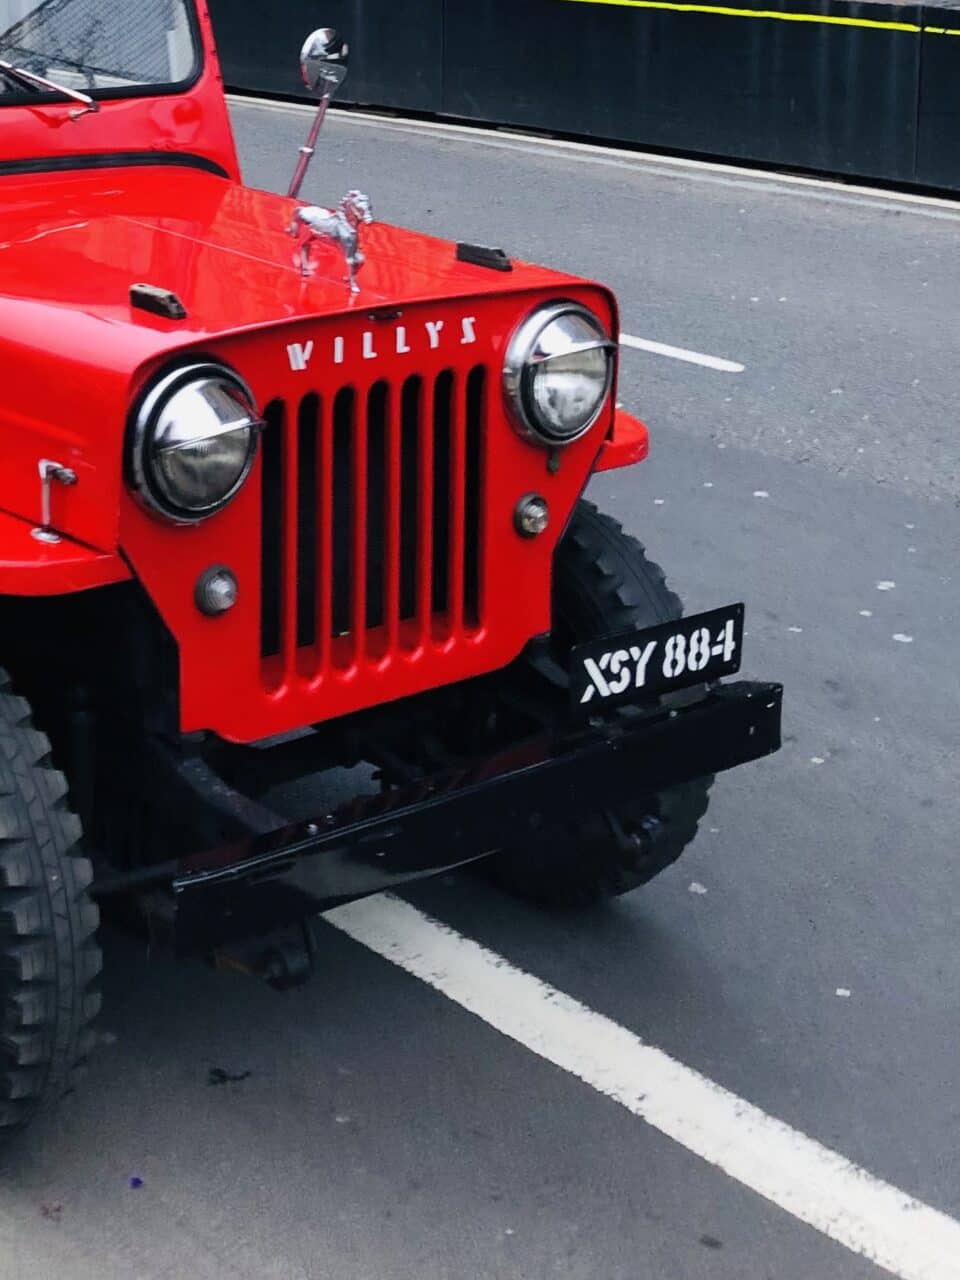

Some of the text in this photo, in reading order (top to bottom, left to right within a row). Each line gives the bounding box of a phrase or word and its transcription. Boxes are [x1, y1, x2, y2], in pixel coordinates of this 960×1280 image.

[286, 316, 476, 371] WILLYS
[580, 619, 736, 703] XSY 884
